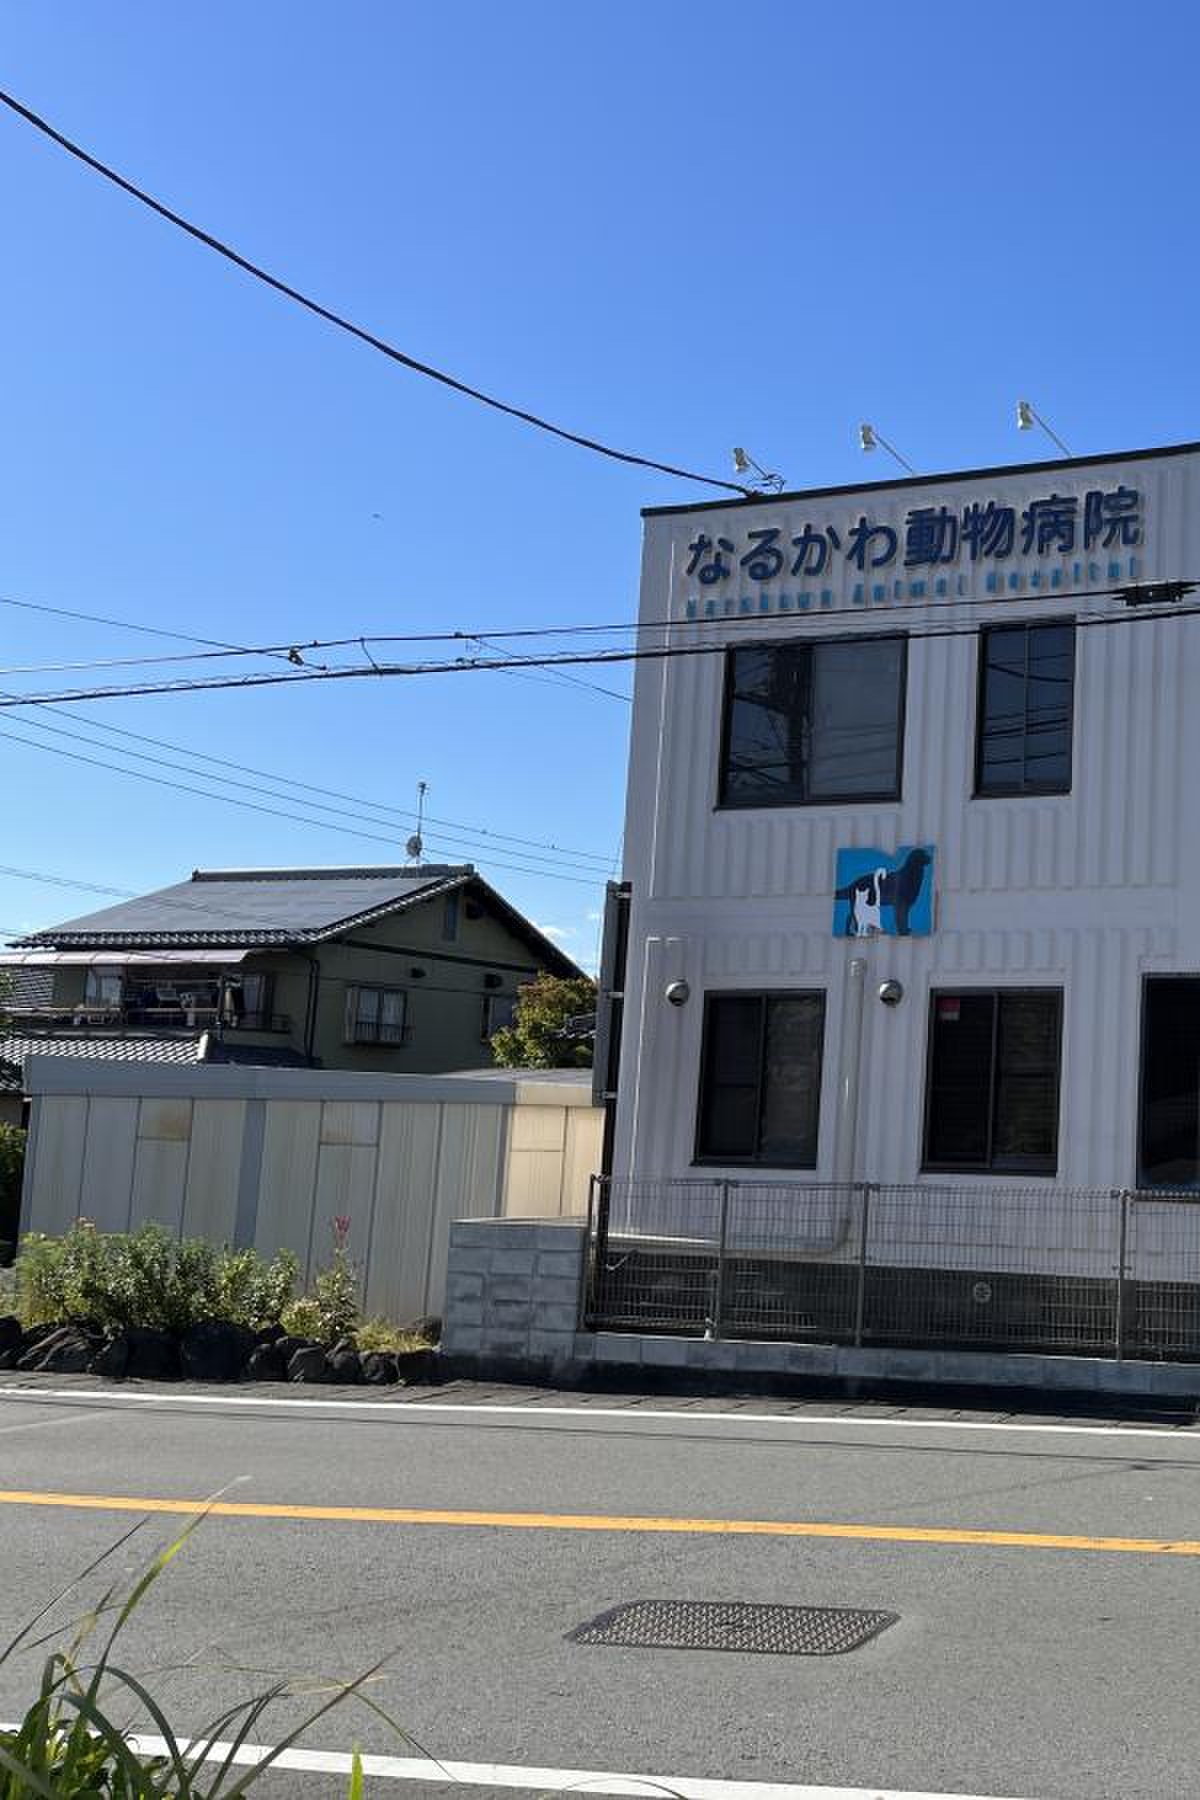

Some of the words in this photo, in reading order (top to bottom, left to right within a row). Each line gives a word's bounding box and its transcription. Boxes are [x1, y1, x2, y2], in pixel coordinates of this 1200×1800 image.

[686, 486, 1142, 584] なるかわ動物病院
